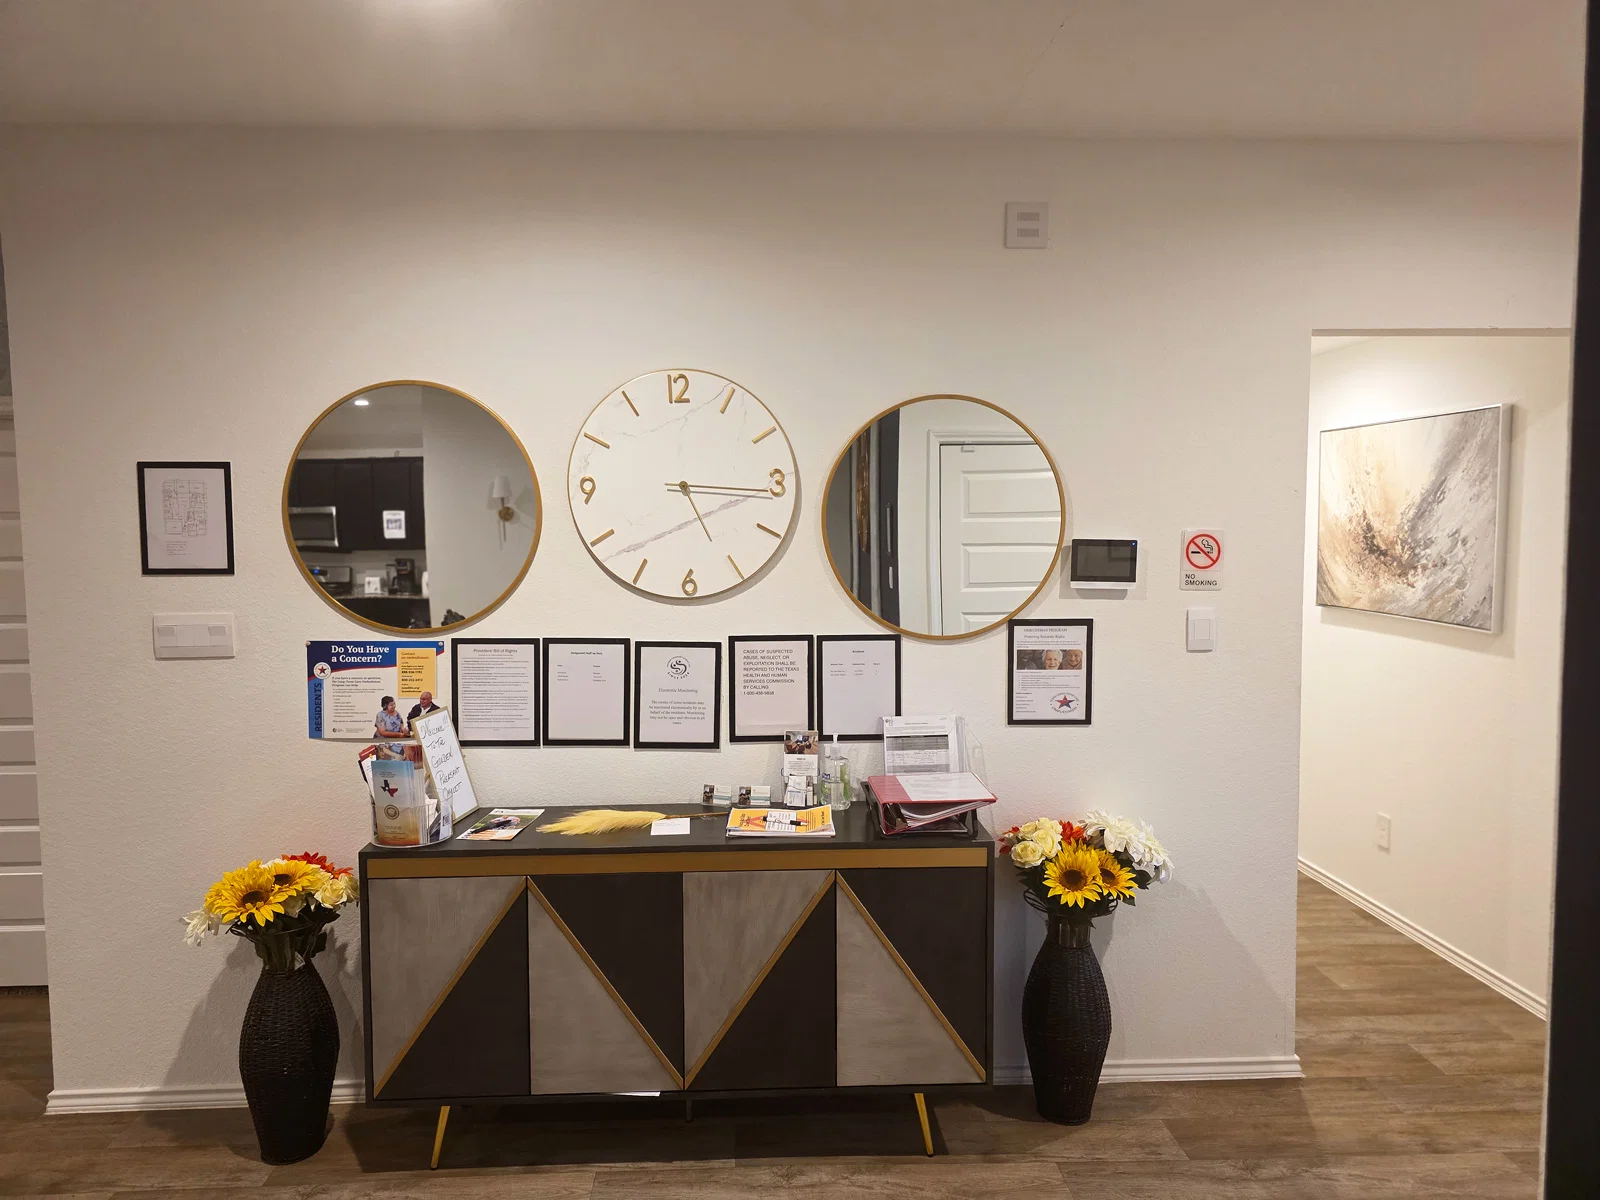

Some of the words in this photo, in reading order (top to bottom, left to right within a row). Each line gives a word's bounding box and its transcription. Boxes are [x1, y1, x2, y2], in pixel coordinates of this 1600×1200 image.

[667, 374, 690, 404] 12
[580, 476, 596, 504] 9
[769, 468, 786, 497] 3
[682, 568, 698, 596] 6
[314, 682, 322, 732] RESIDENTS
[431, 745, 453, 768] GOLDEN
